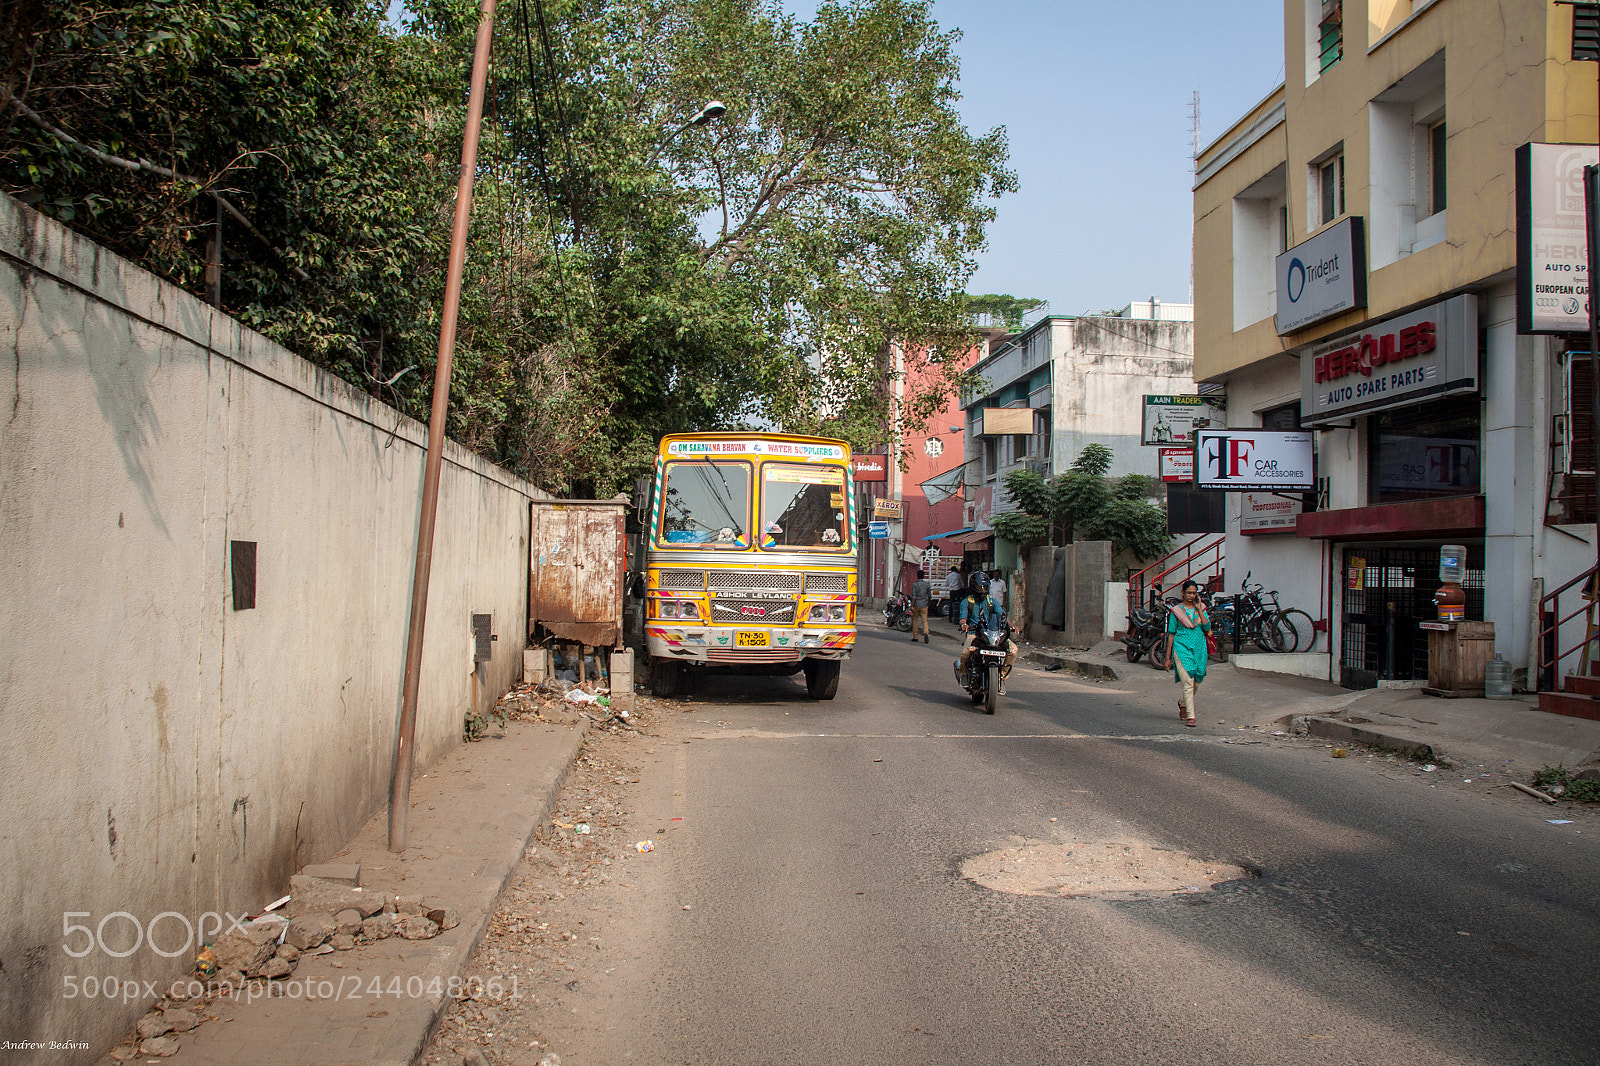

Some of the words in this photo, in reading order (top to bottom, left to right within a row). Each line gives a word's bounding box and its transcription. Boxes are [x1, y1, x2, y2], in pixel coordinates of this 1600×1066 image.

[1535, 244, 1587, 260] HERC
[1306, 253, 1339, 283] Trident
[1545, 263, 1571, 272] AUTO
[1575, 264, 1588, 272] SP
[1535, 284, 1573, 294] EUROPEAN
[1314, 320, 1437, 384] HERCULES
[1328, 386, 1353, 405] AUTO
[1357, 377, 1387, 398] SPARE
[1391, 367, 1425, 389] PARTS
[1153, 396, 1171, 404] AAIN
[1172, 396, 1202, 405] TRADERS
[678, 443, 688, 452] OM
[689, 443, 721, 452] SARAVANA
[722, 443, 746, 452] BHAVAN
[768, 445, 792, 454] WATER
[794, 446, 833, 456] SUPPLIERS
[1254, 460, 1278, 470] CAR
[1254, 470, 1304, 478] ACCESSORIES
[877, 502, 900, 510] XEROX
[1252, 501, 1292, 512] PROFESSIONAL
[716, 591, 747, 599] ASHOK
[752, 592, 793, 600] LEYLAND
